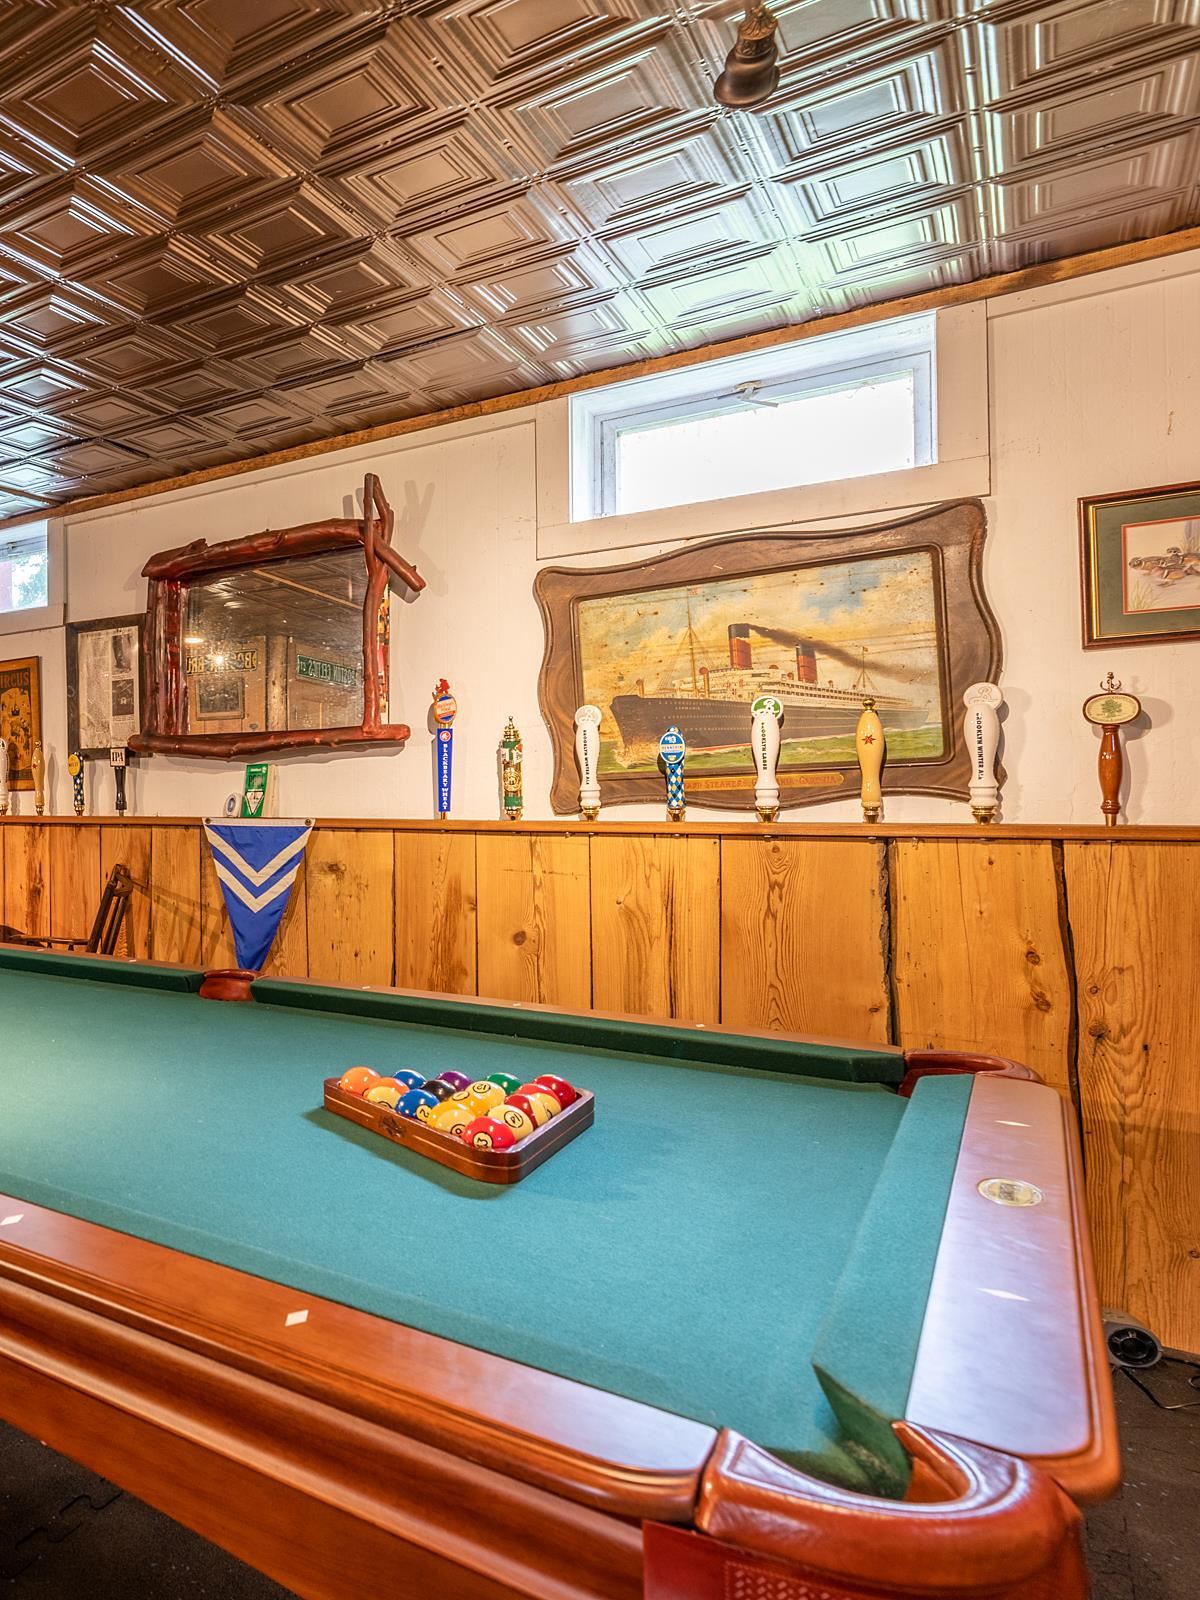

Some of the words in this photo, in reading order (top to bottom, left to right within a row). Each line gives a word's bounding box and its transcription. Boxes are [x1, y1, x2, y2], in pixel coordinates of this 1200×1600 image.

[111, 751, 124, 762] IPA
[441, 788, 449, 810] WHEAT
[419, 1108, 430, 1118] 2
